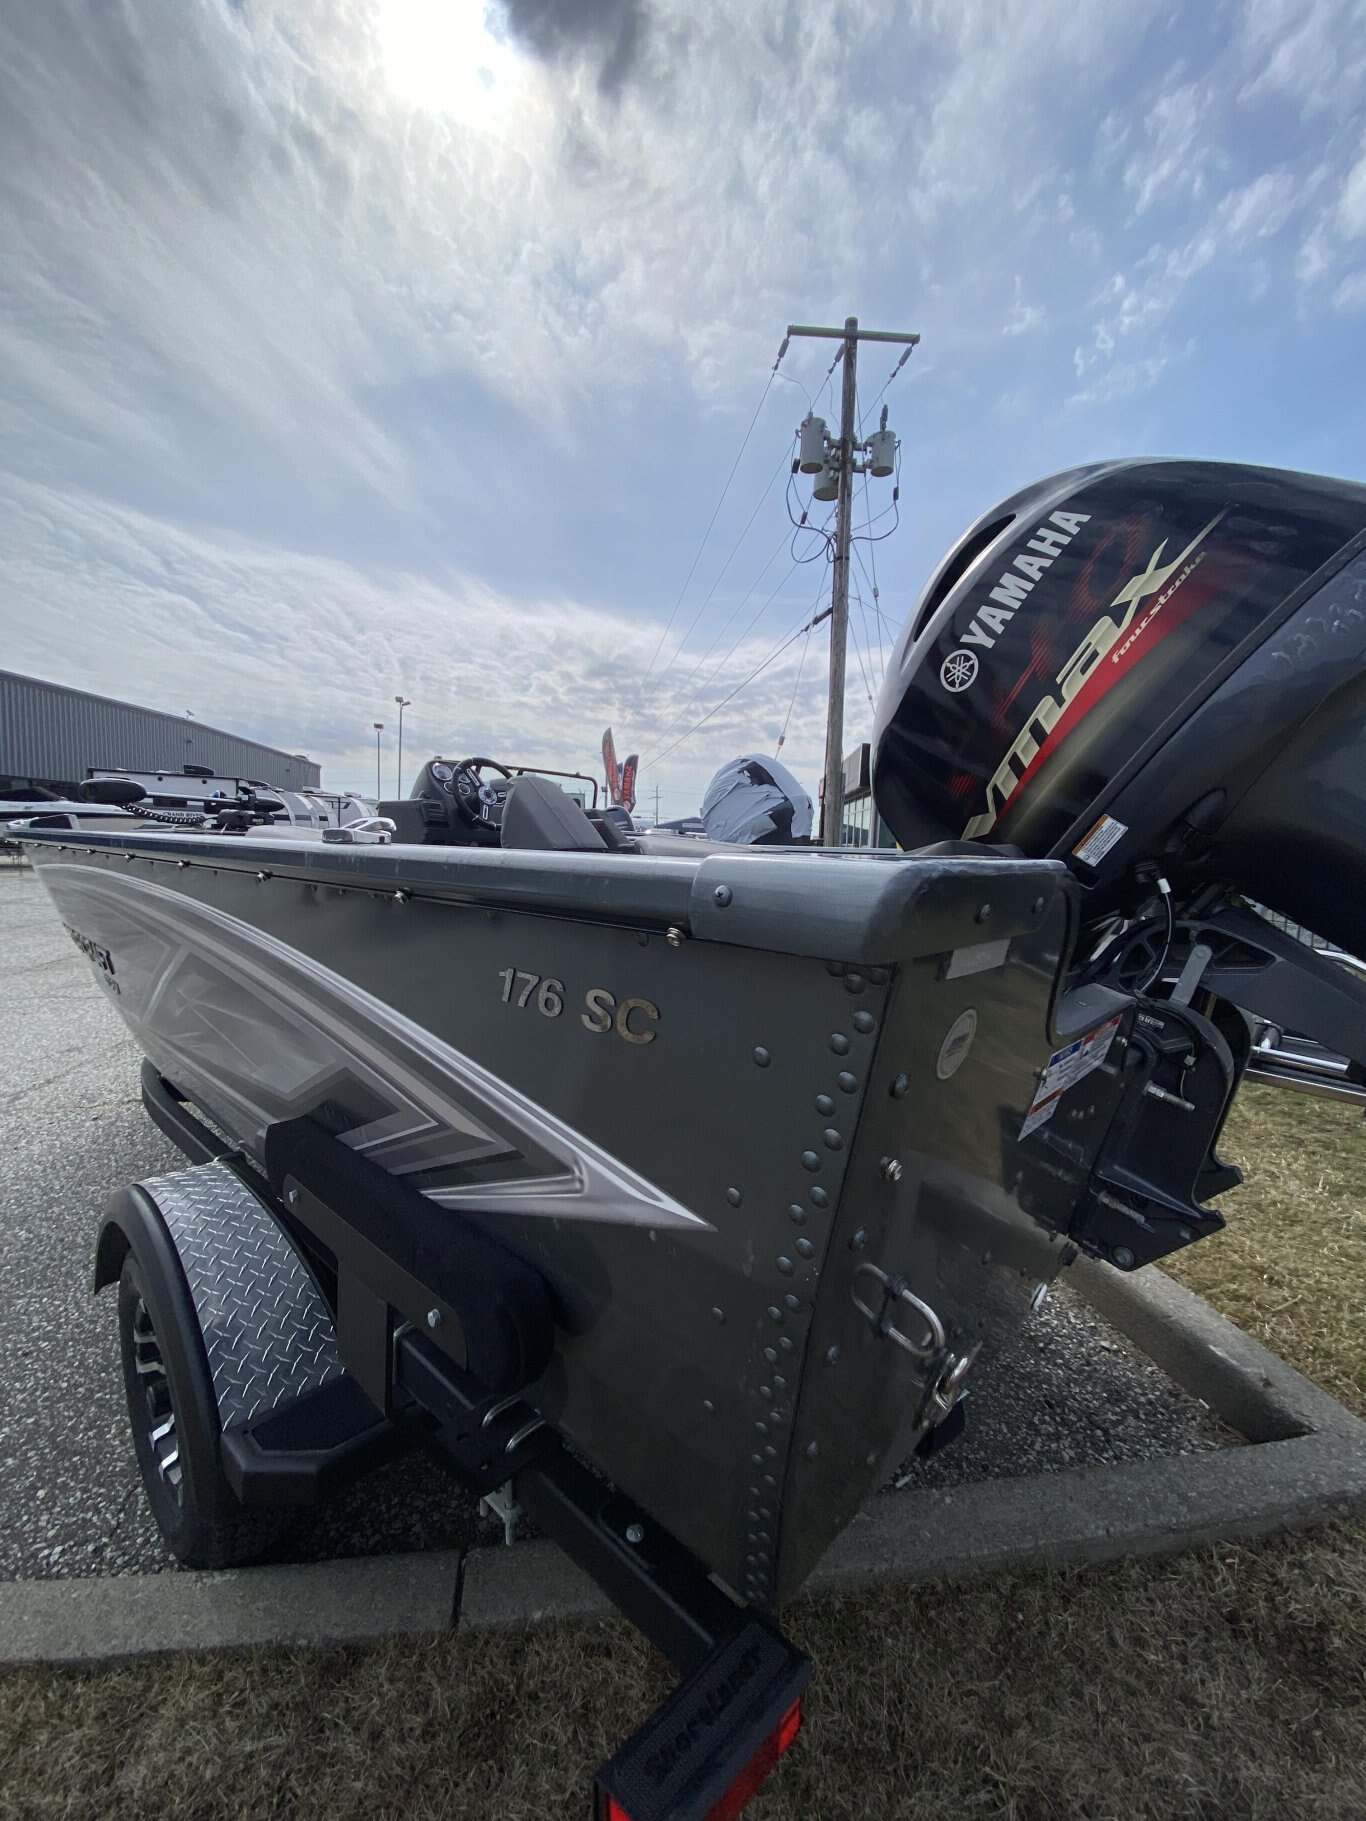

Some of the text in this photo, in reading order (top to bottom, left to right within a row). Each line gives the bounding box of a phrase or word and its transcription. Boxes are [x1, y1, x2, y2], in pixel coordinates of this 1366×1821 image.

[960, 510, 1092, 649] YAMAHA
[498, 968, 660, 1045] 176 SC
